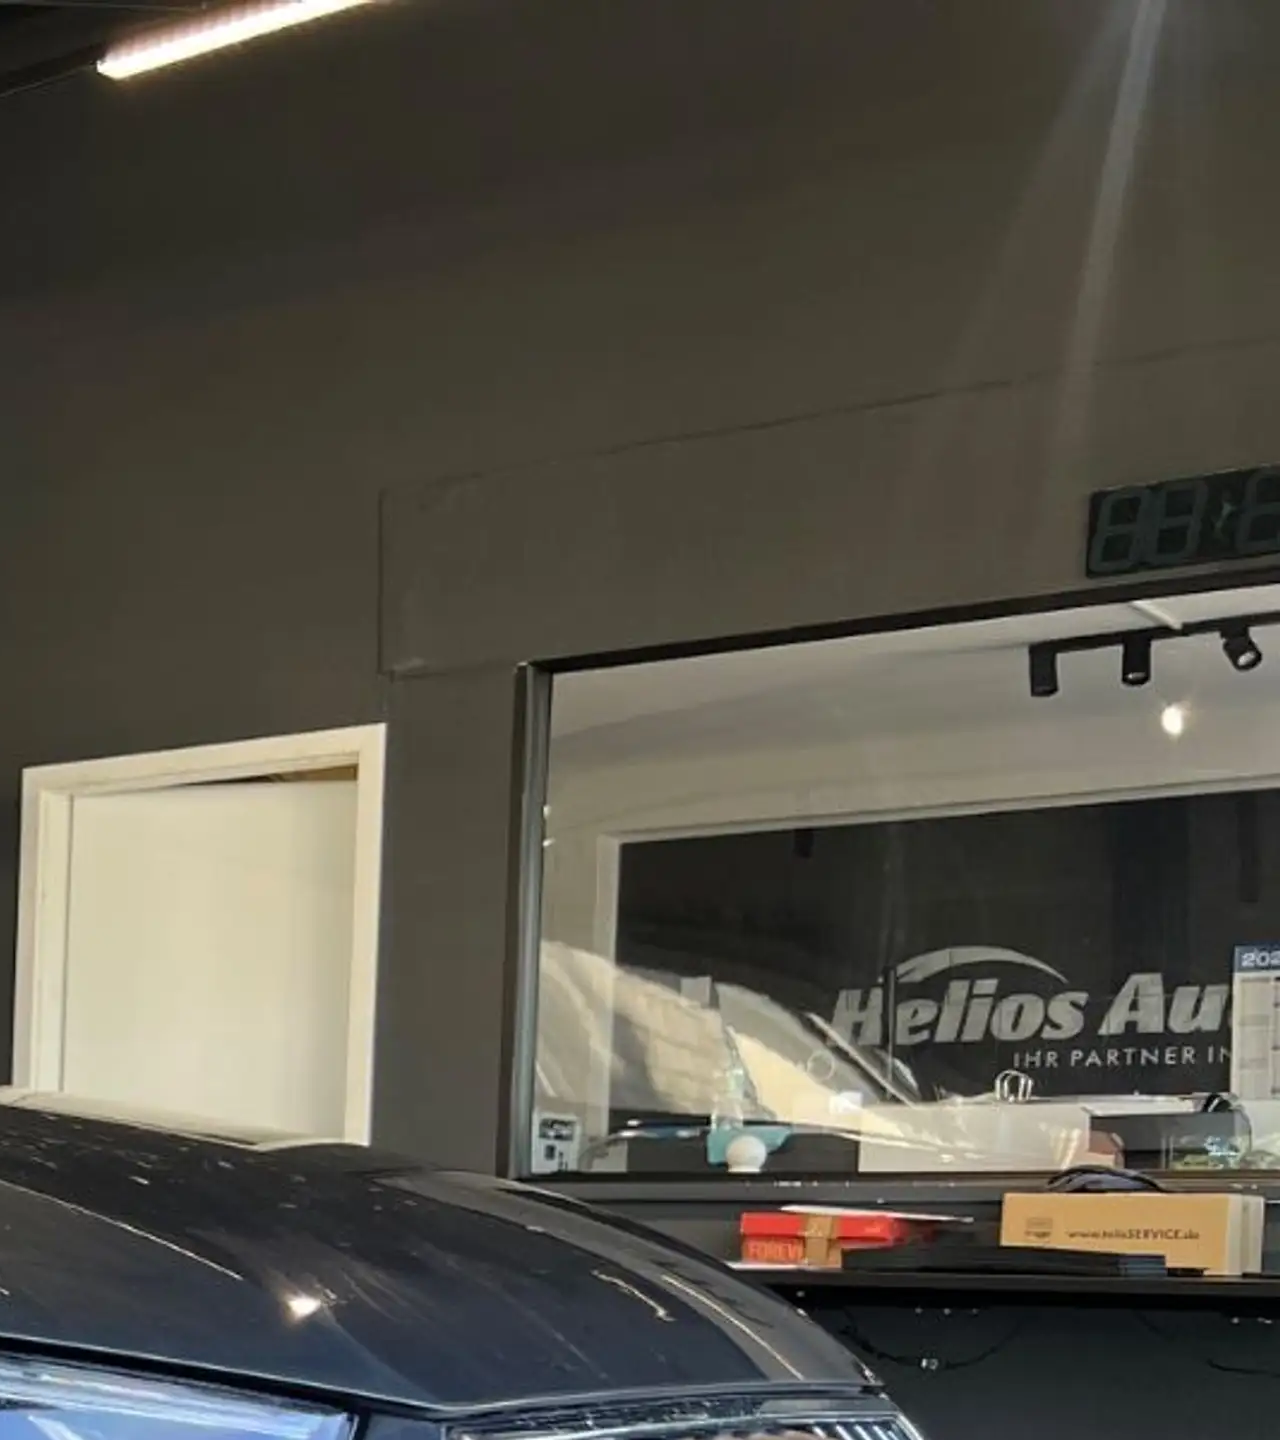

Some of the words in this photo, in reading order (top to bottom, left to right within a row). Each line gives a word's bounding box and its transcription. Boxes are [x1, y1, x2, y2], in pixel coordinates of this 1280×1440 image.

[832, 978, 1090, 1047] Helios
[1098, 972, 1233, 1036] Au
[1013, 1050, 1059, 1069] IHR
[1070, 1046, 1196, 1068] PARTNER
